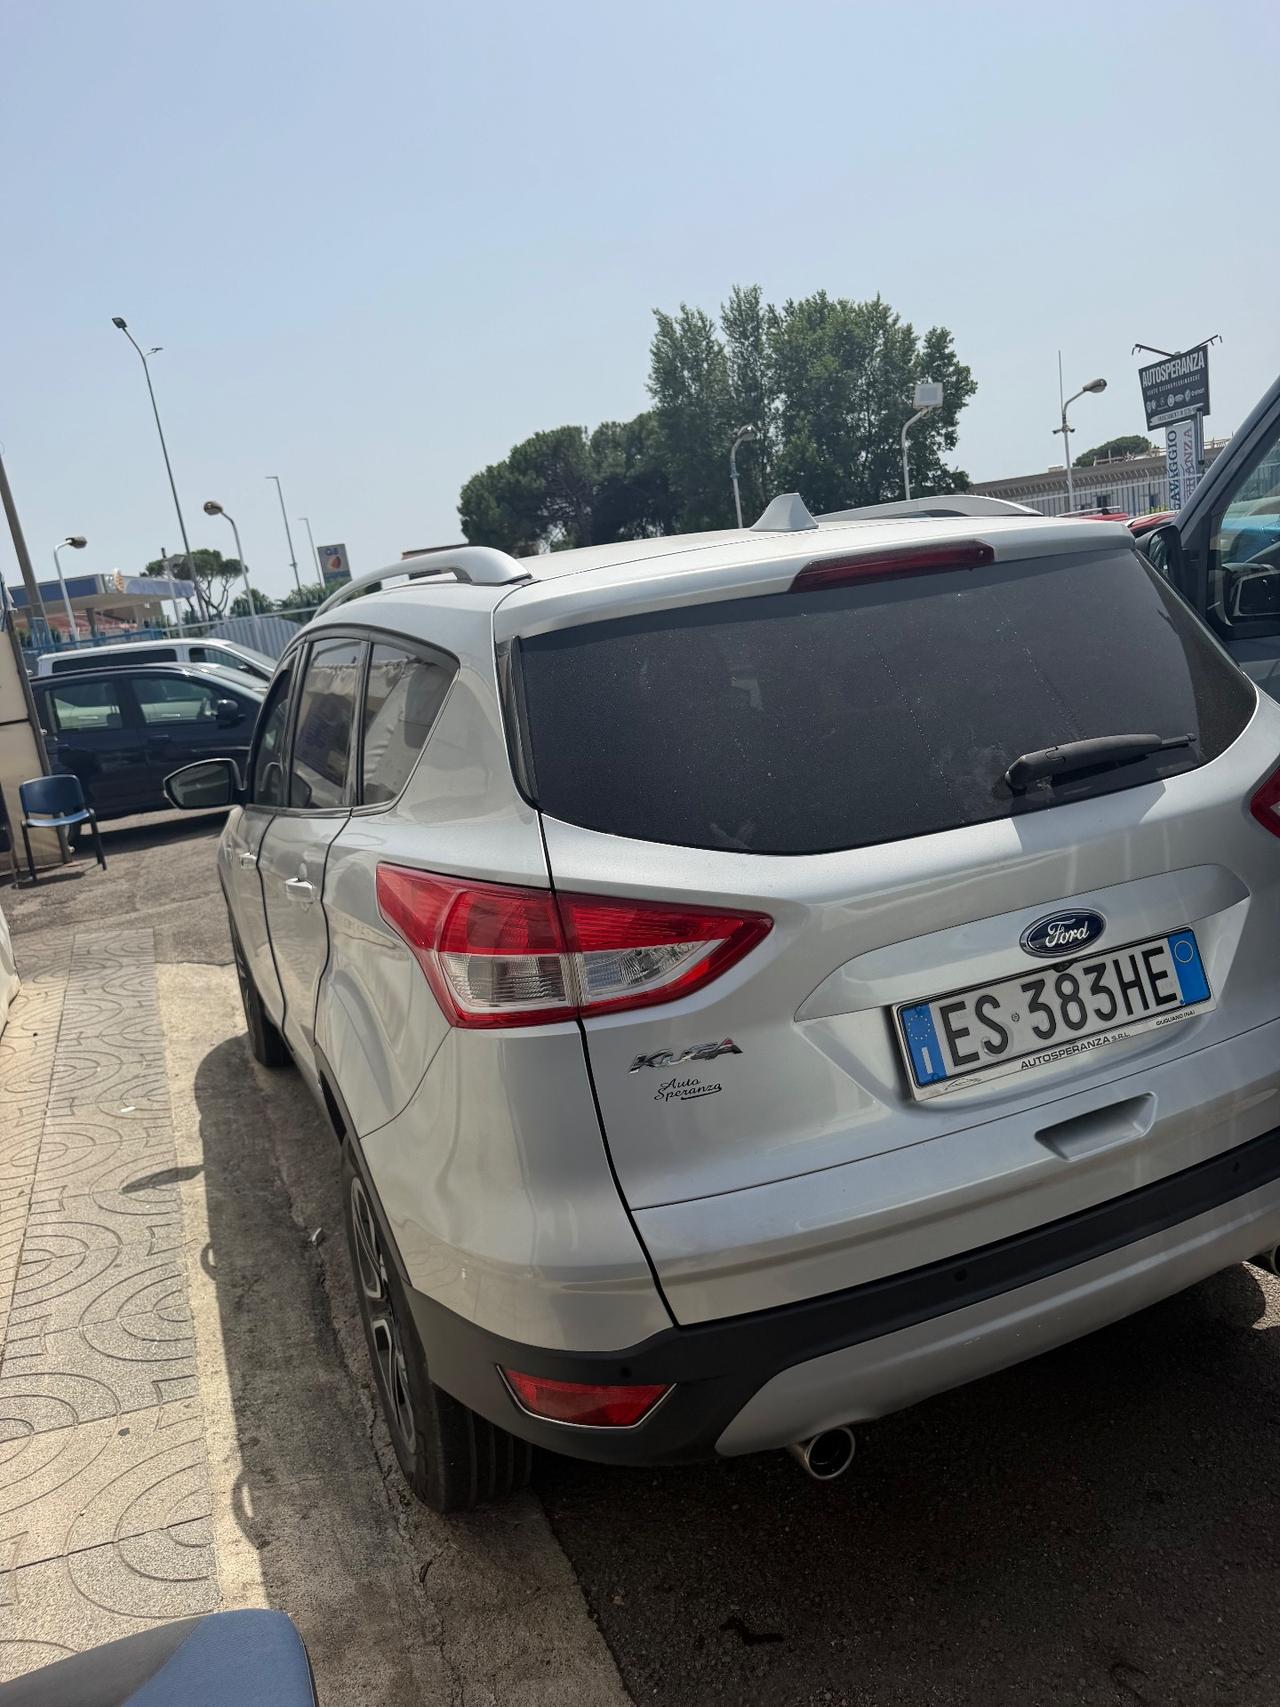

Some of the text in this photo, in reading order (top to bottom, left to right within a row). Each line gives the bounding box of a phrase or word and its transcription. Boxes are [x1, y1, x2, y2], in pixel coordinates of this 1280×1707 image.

[1142, 350, 1205, 388] AUTOSPERANZA
[1044, 919, 1089, 947] Ford
[938, 994, 1009, 1067] ES
[1021, 946, 1178, 1041] 383HE
[1020, 1036, 1111, 1070] AUTOSPERANZA
[654, 1083, 722, 1101] Speranza
[660, 1078, 700, 1090] Auto
